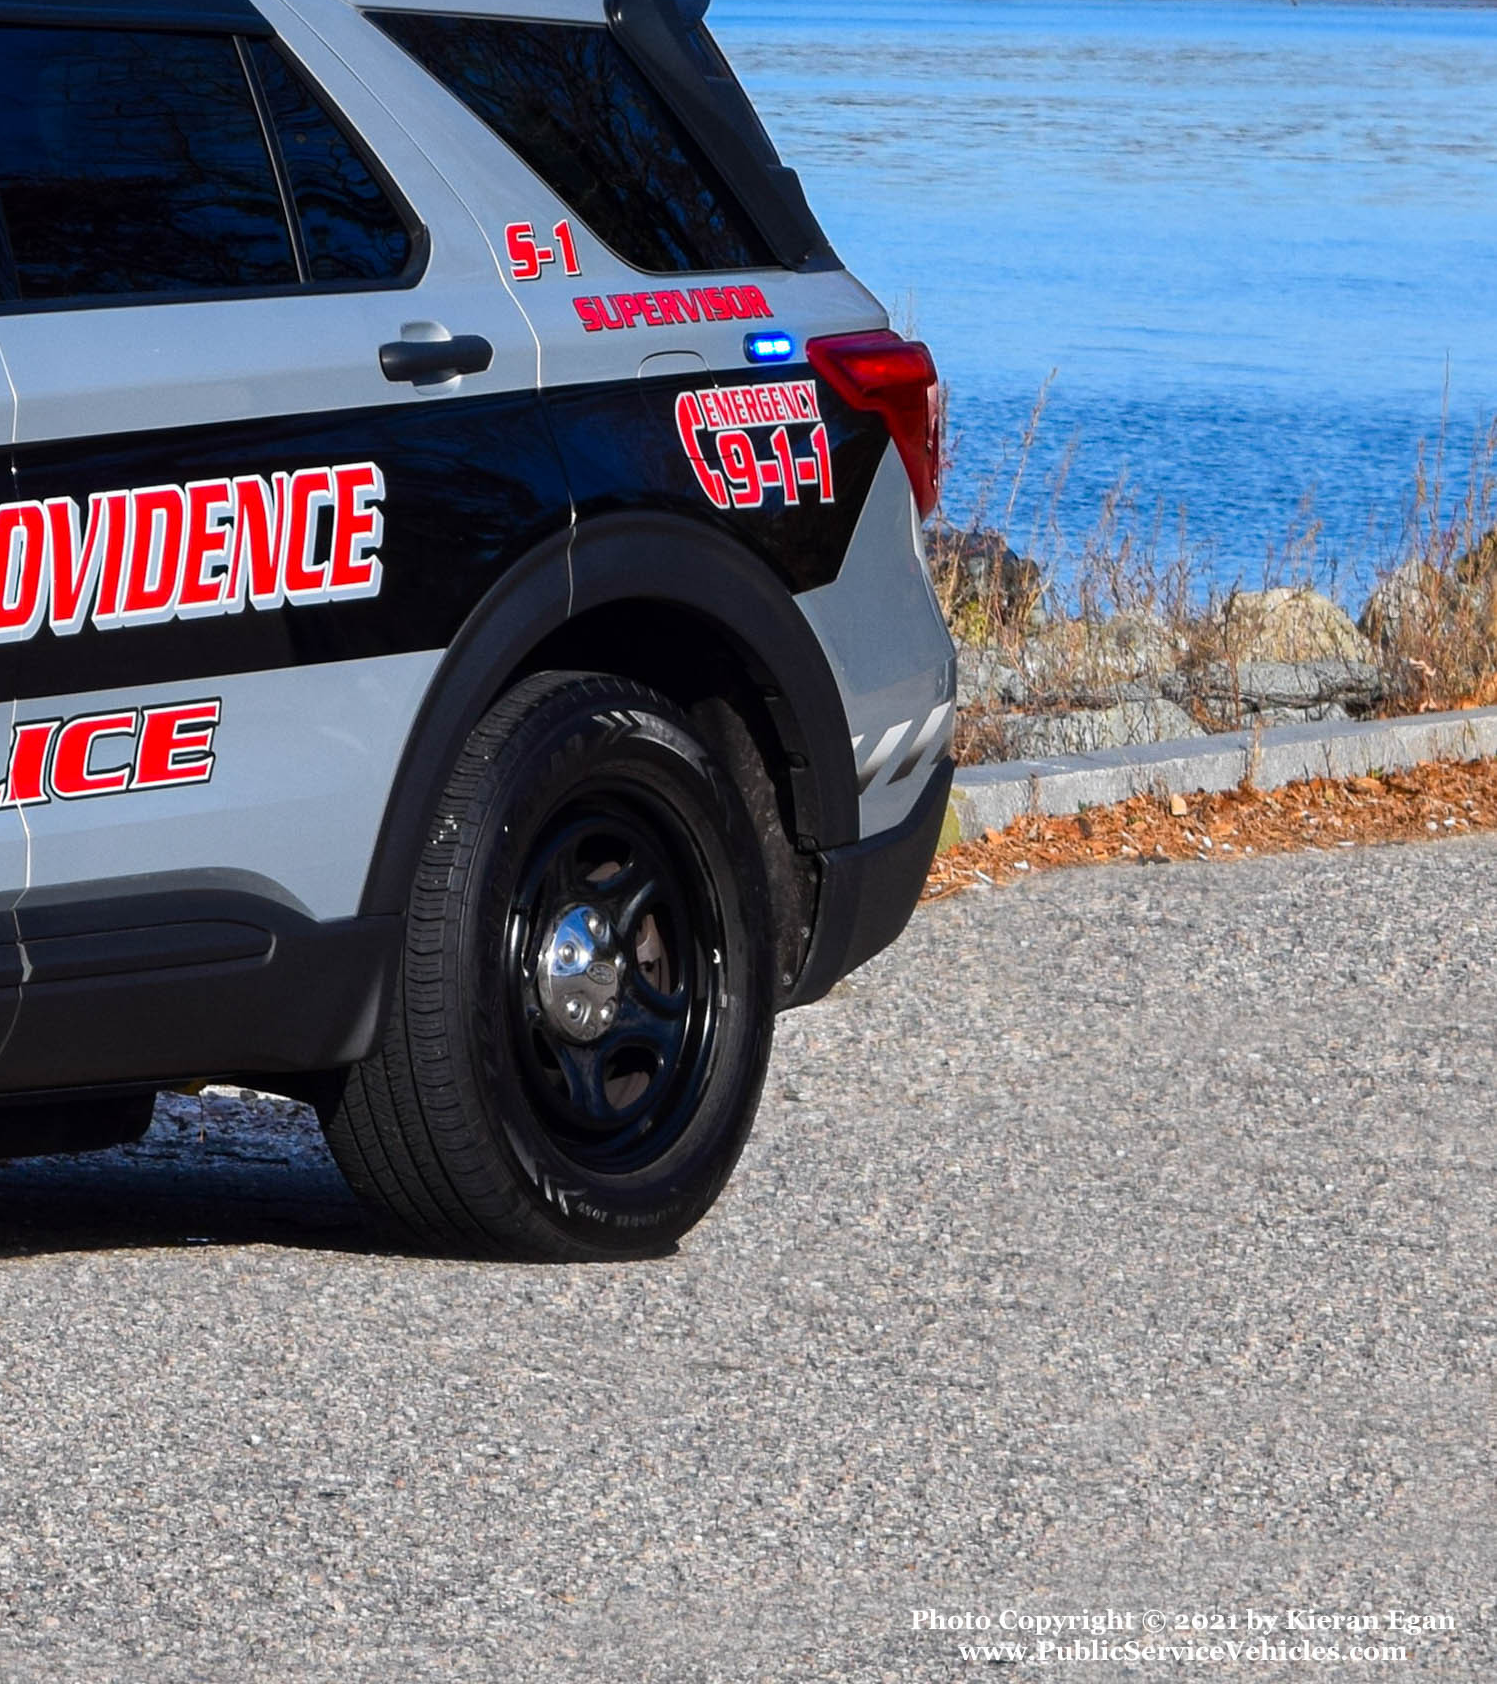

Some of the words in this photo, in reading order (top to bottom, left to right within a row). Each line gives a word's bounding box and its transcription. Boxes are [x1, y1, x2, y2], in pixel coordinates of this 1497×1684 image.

[504, 219, 580, 280] S-1
[573, 285, 773, 332] SUPERVISOR
[695, 380, 821, 431] EMERGENCY
[715, 422, 835, 509] 9-1-1
